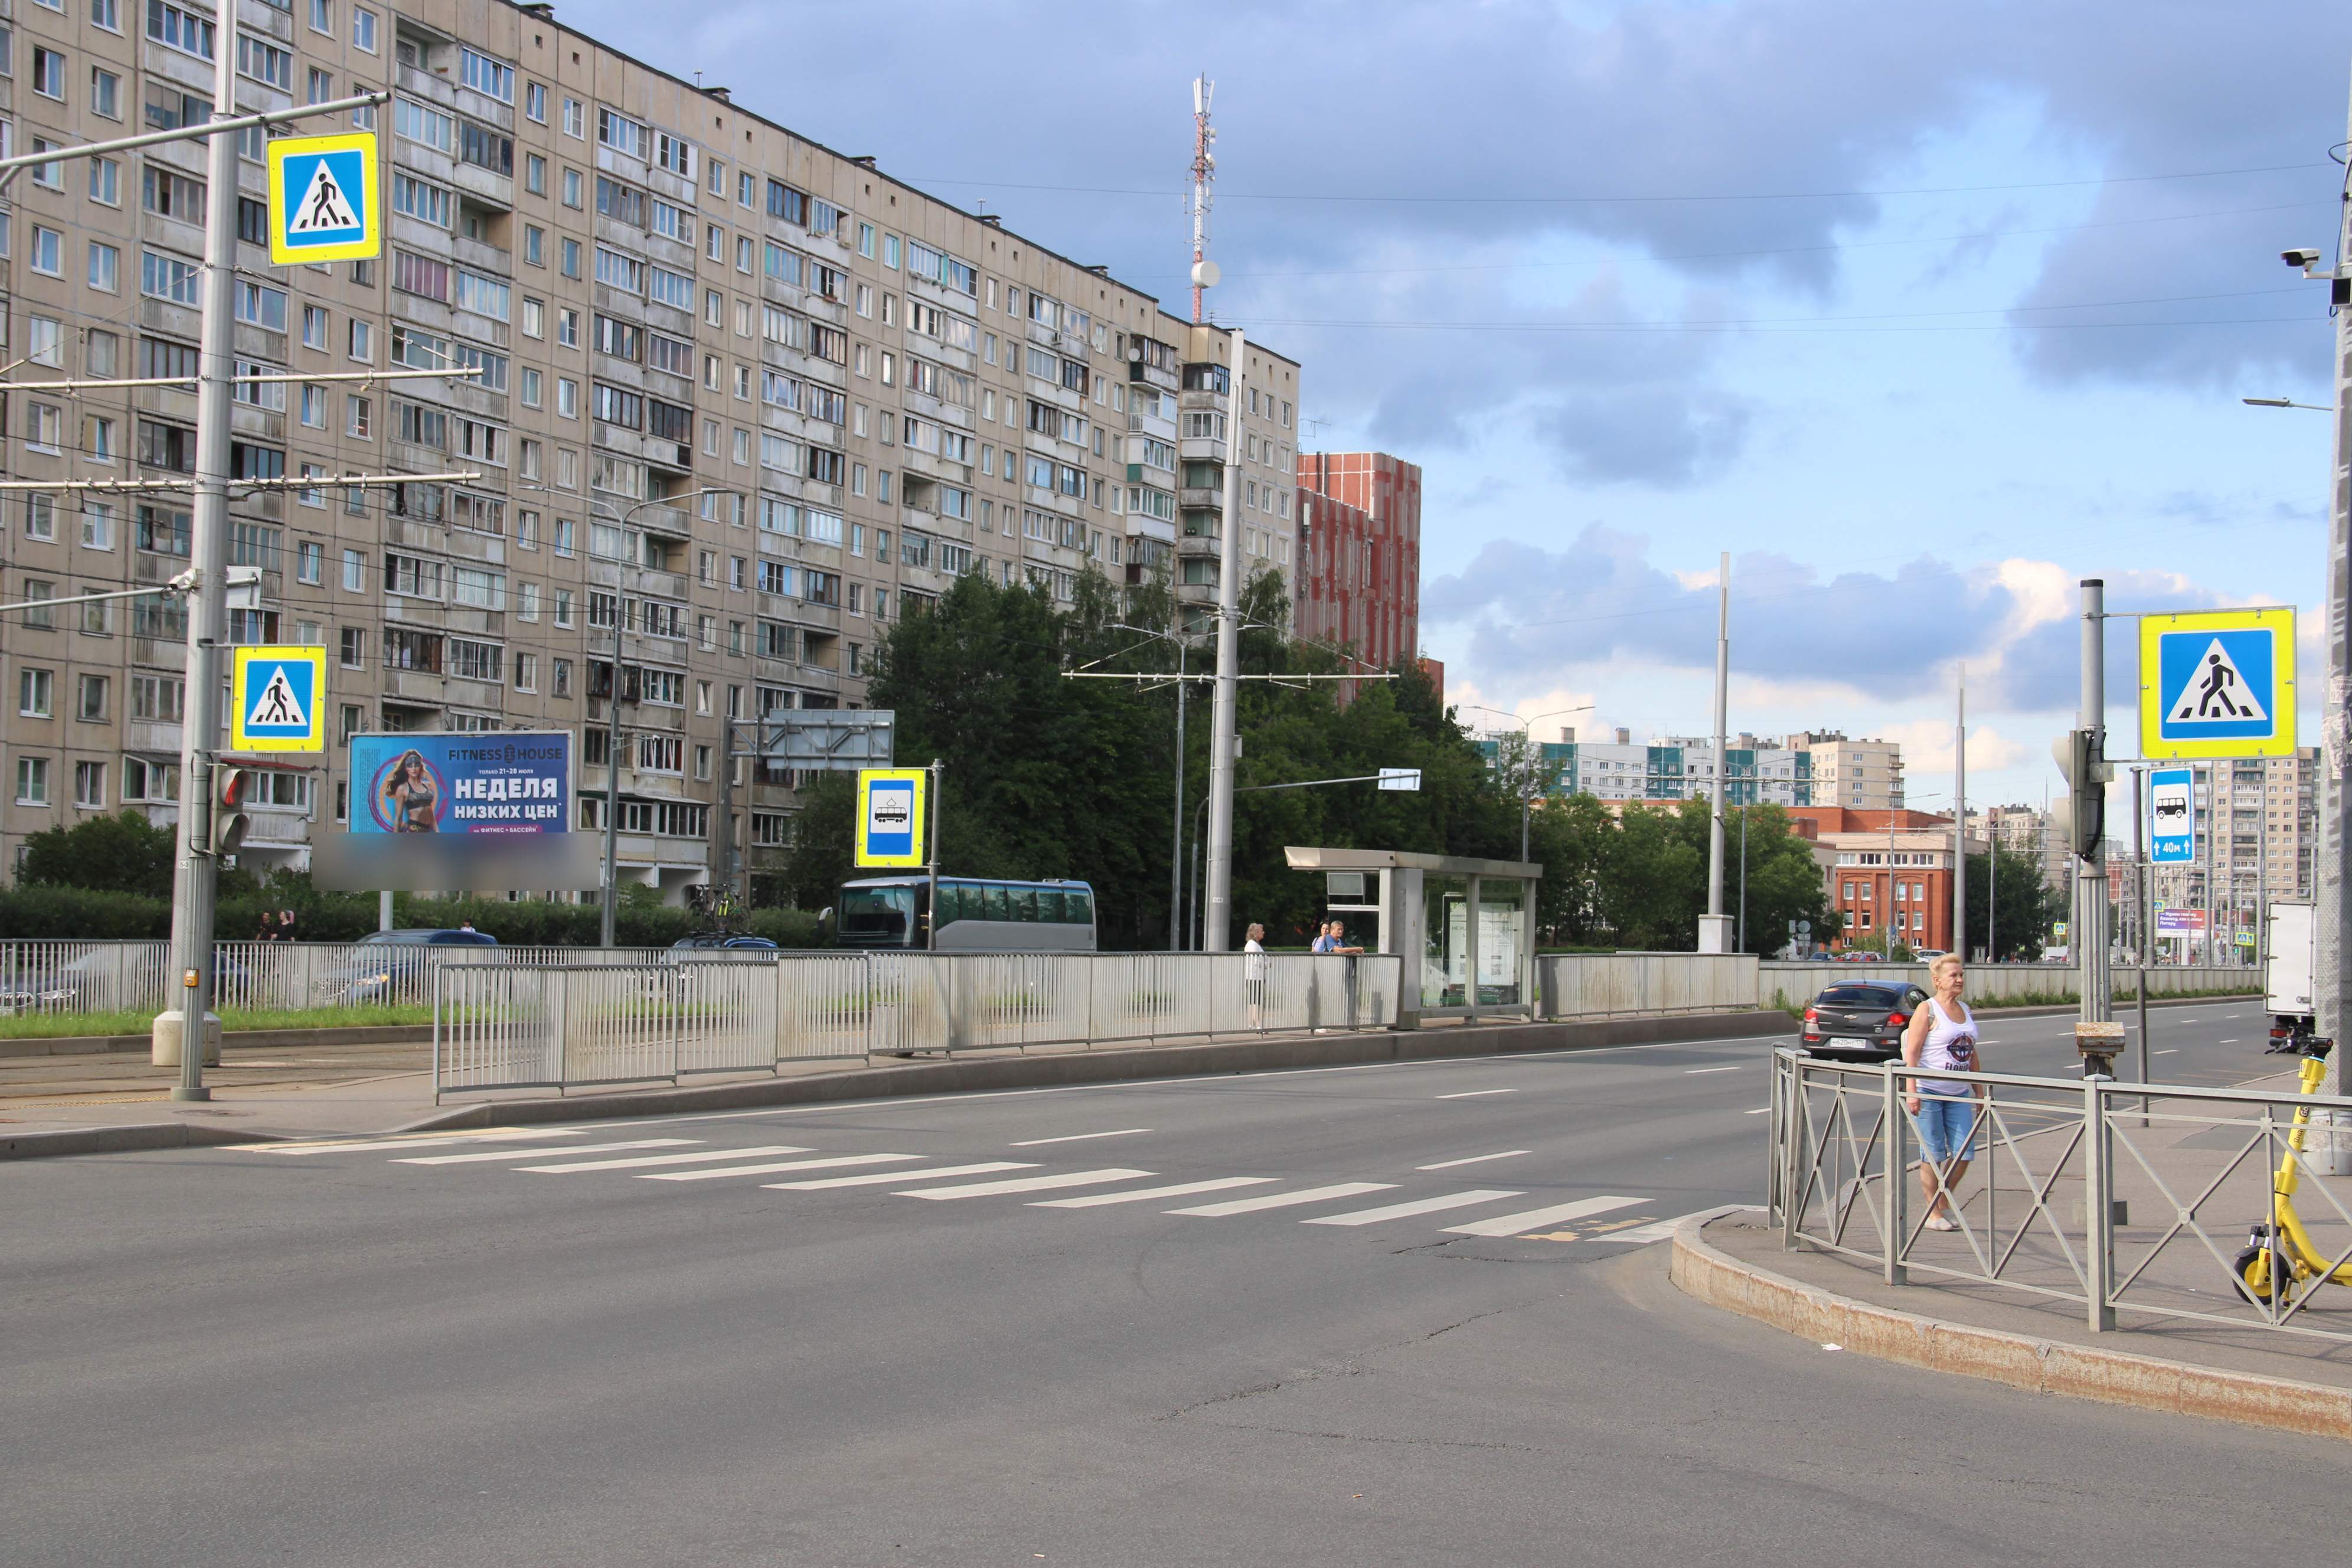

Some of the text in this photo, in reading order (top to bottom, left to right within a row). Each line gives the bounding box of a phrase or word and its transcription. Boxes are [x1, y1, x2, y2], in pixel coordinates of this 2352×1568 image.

[449, 748, 563, 760] FITNESS HOUSE
[455, 778, 557, 802] НЕДЕЛЯ
[455, 805, 521, 819] НИЗКИХ
[2162, 842, 2181, 853] 40м
